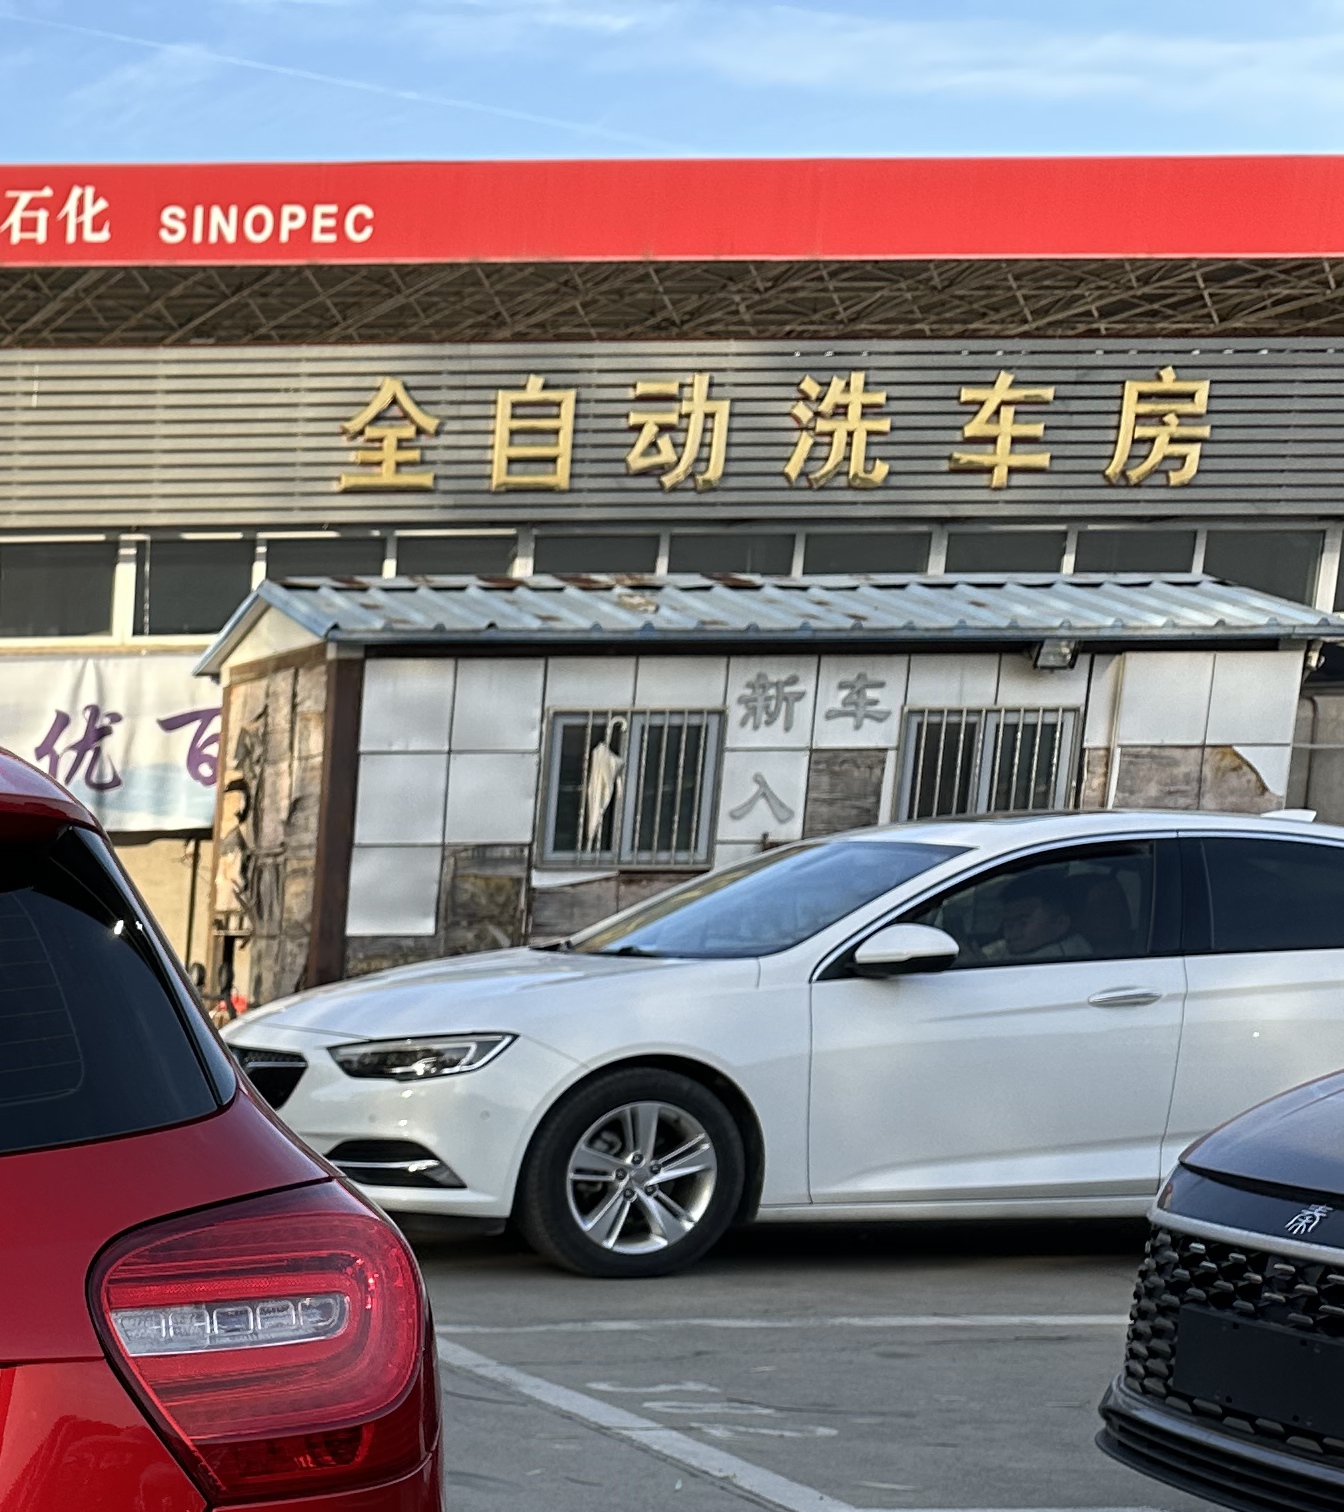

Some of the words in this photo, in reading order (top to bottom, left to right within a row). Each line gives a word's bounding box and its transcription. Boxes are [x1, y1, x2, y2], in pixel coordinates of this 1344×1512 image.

[159, 204, 375, 244] SINOPEC
[338, 366, 1213, 491] 全自动洗车房
[737, 671, 891, 731] 新车
[730, 773, 794, 825] 入
